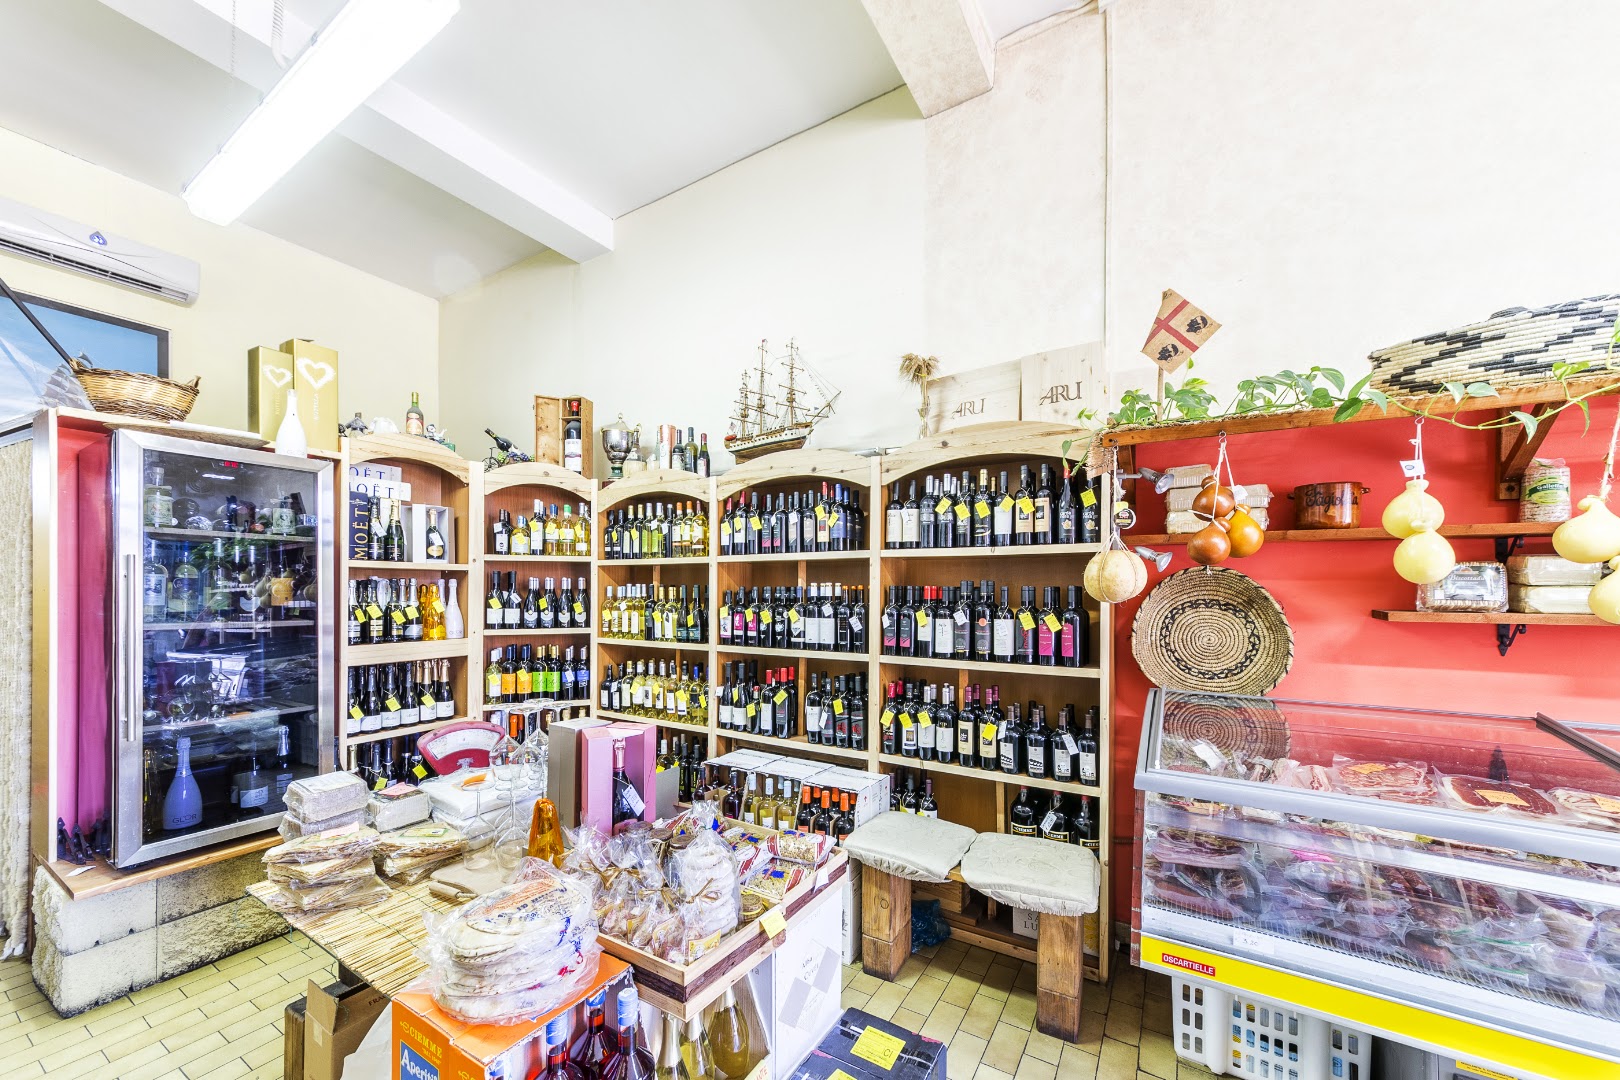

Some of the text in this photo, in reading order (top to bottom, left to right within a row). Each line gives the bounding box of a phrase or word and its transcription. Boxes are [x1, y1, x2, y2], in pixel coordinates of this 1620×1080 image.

[1039, 380, 1083, 406] ARU
[952, 398, 986, 419] ARU
[349, 466, 385, 480] OËT
[349, 482, 394, 499] OËT
[352, 507, 369, 560] MOËT
[1163, 954, 1214, 975] OSCARTIELLE
[409, 1026, 442, 1058] CIEMME
